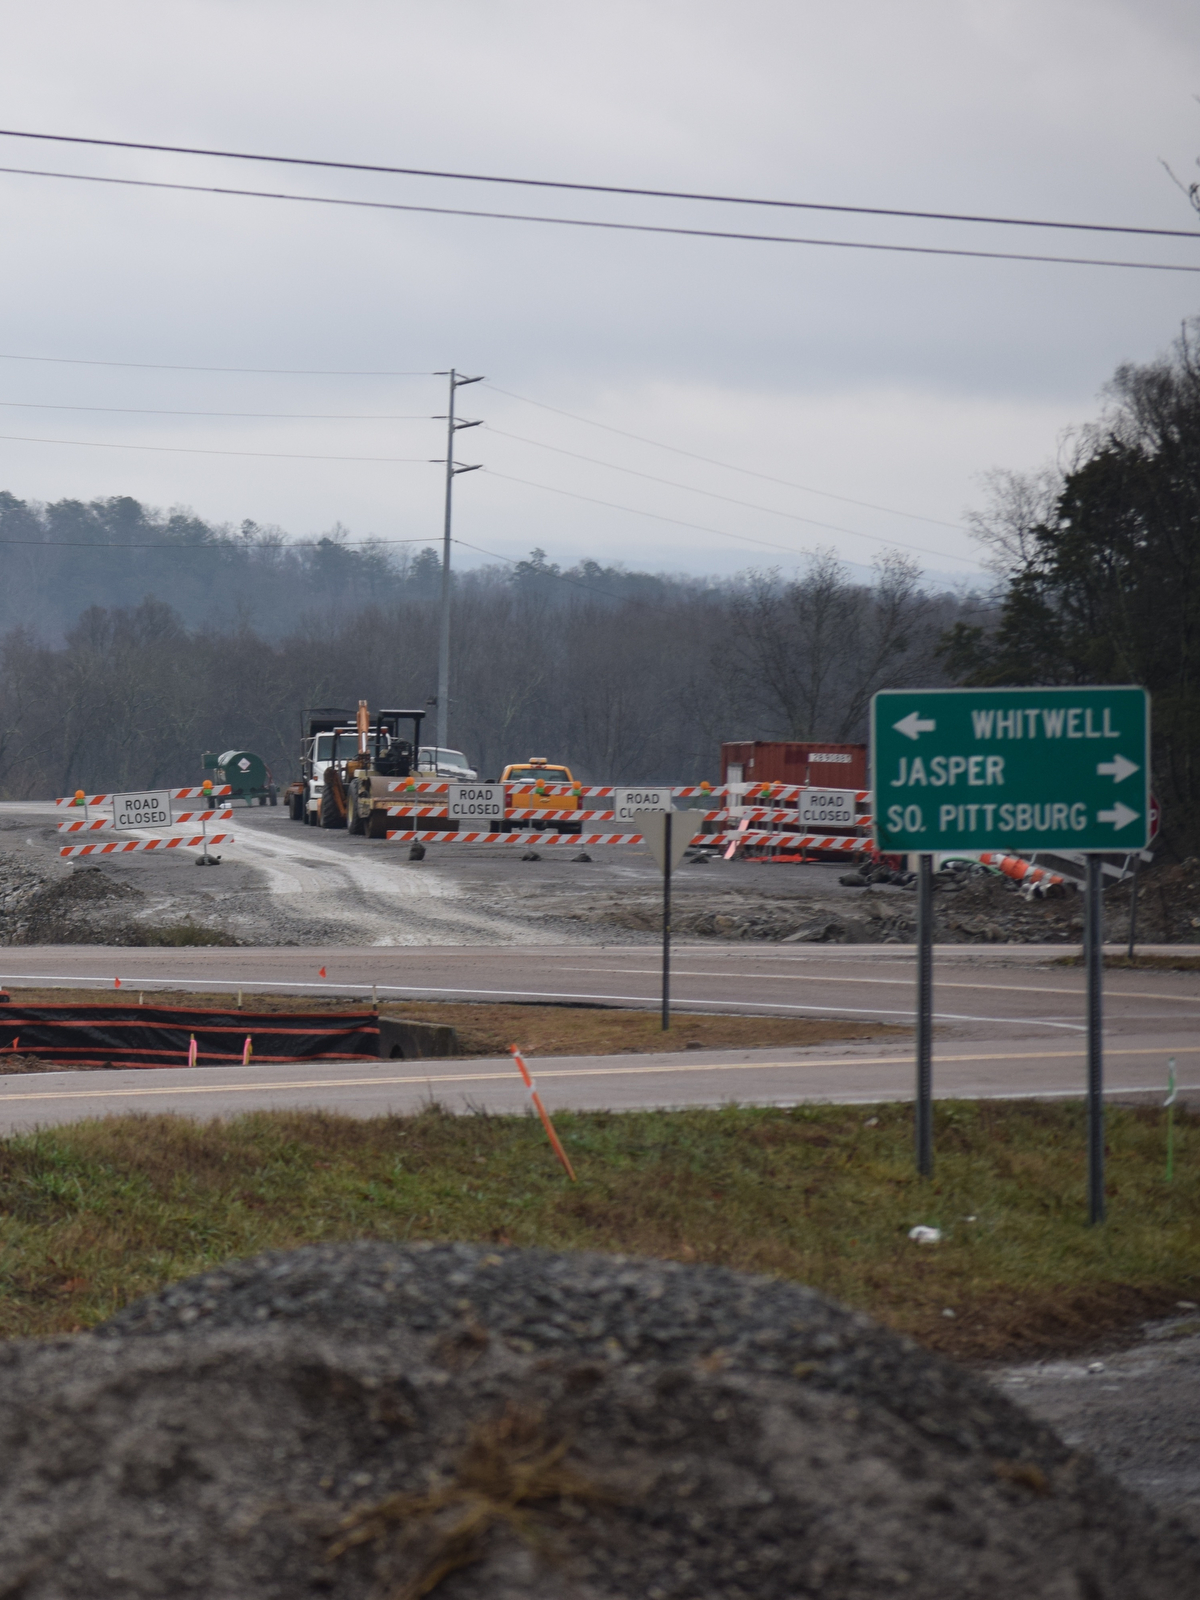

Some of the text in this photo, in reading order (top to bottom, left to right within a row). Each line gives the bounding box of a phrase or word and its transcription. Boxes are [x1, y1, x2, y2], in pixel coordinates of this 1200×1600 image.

[971, 707, 1121, 740] WHITWELL
[890, 755, 1005, 787] JASPER
[460, 789, 493, 801] ROAD
[626, 793, 660, 804] ROAD
[811, 796, 844, 807] ROAD
[125, 798, 159, 811] ROAD
[452, 803, 499, 816] CLOSED
[119, 811, 167, 825] CLOSED
[803, 810, 850, 822] CLOSED
[887, 803, 1088, 833] SO. PITTSBURG
